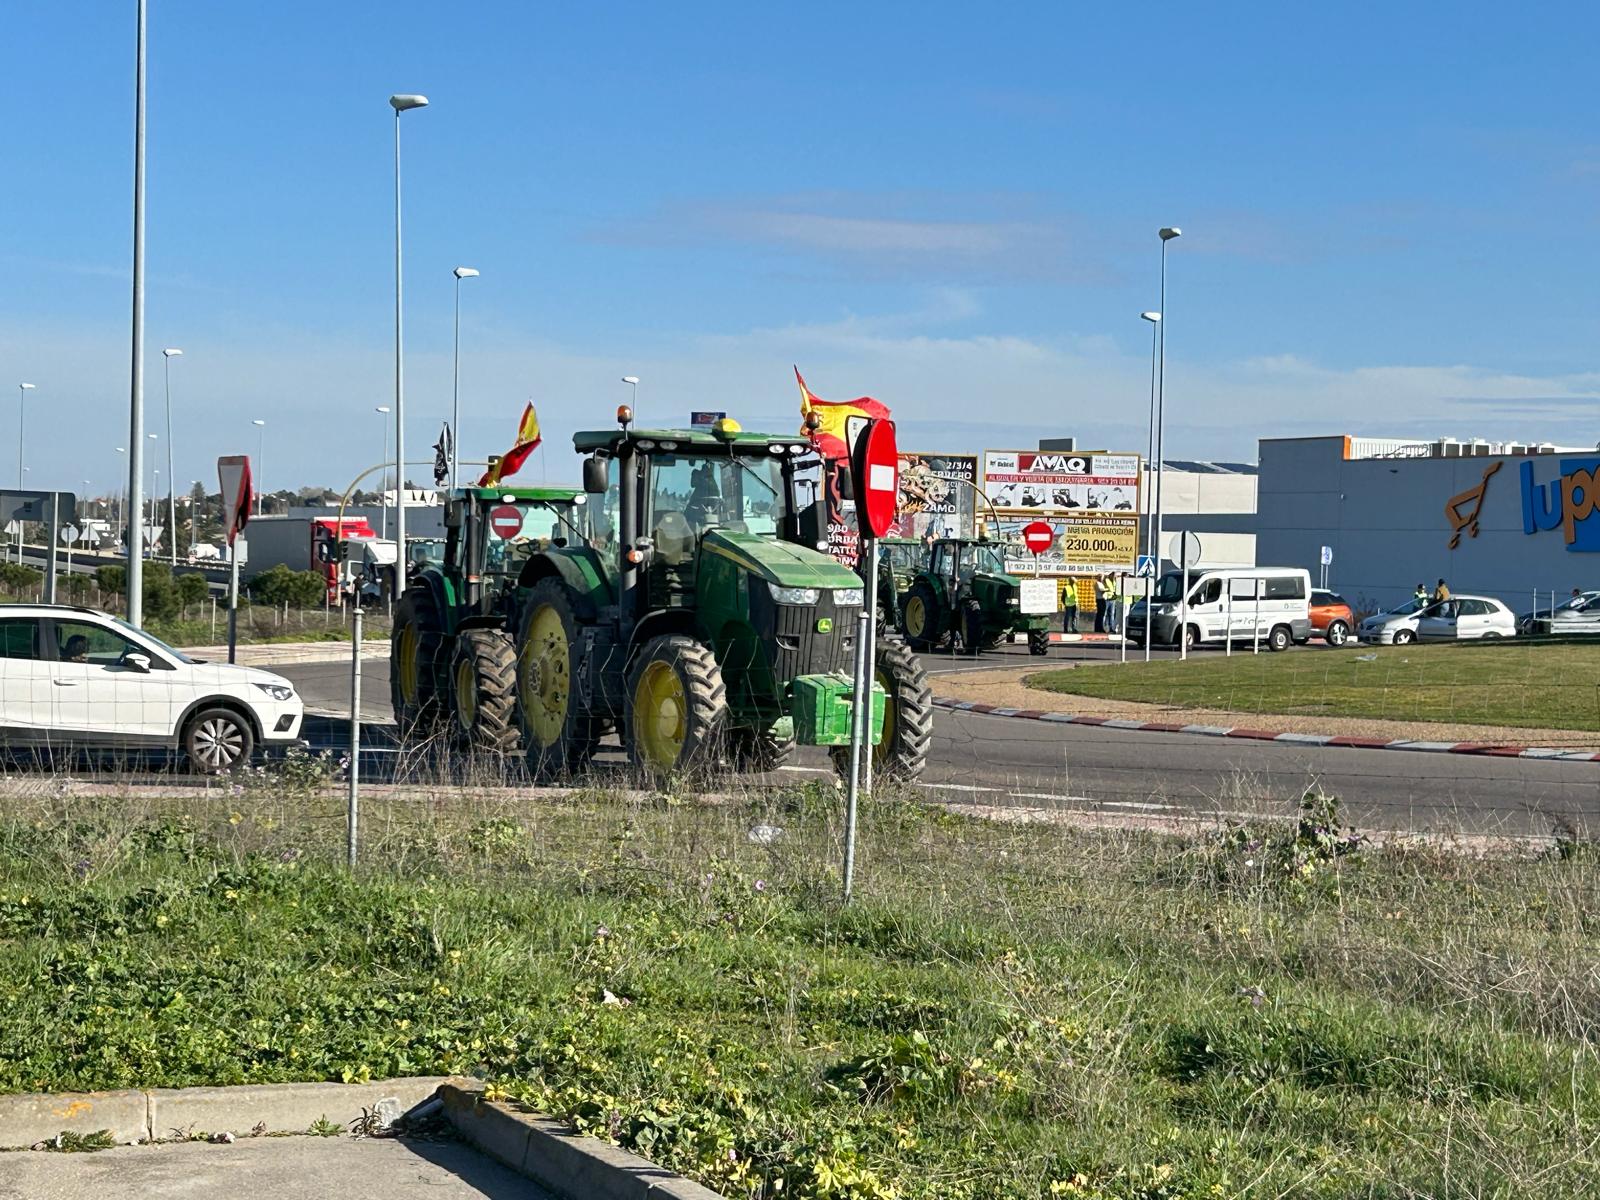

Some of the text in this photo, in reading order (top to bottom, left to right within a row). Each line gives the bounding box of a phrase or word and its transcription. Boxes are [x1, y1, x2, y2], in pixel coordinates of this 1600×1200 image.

[945, 461, 973, 471] 2/3/4
[1024, 455, 1086, 474] AMAQ
[1067, 526, 1134, 536] NUEVA PROMOCIÓN
[1066, 539, 1115, 552] 230.000
